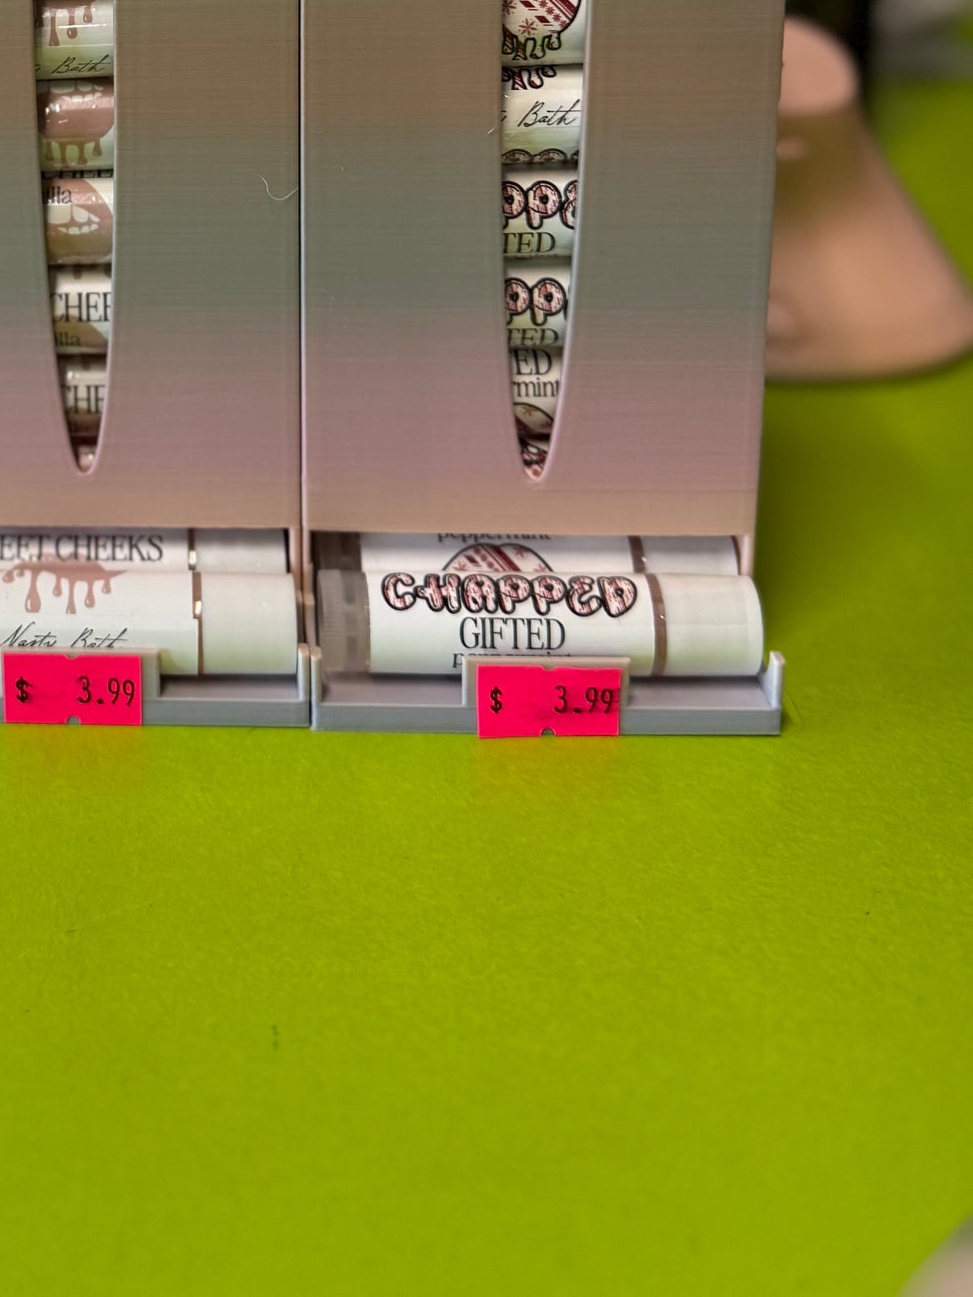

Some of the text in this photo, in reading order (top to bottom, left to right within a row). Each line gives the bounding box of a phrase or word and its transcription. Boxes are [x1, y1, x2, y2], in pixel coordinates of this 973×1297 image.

[51, 54, 111, 75] Bath
[517, 99, 582, 128] Bath
[55, 534, 163, 562] CHEEKS
[381, 571, 638, 618] CHAPPED
[459, 616, 566, 650] GIFTED
[15, 676, 135, 706] $ 3.99
[490, 685, 615, 714] $ 3.99
